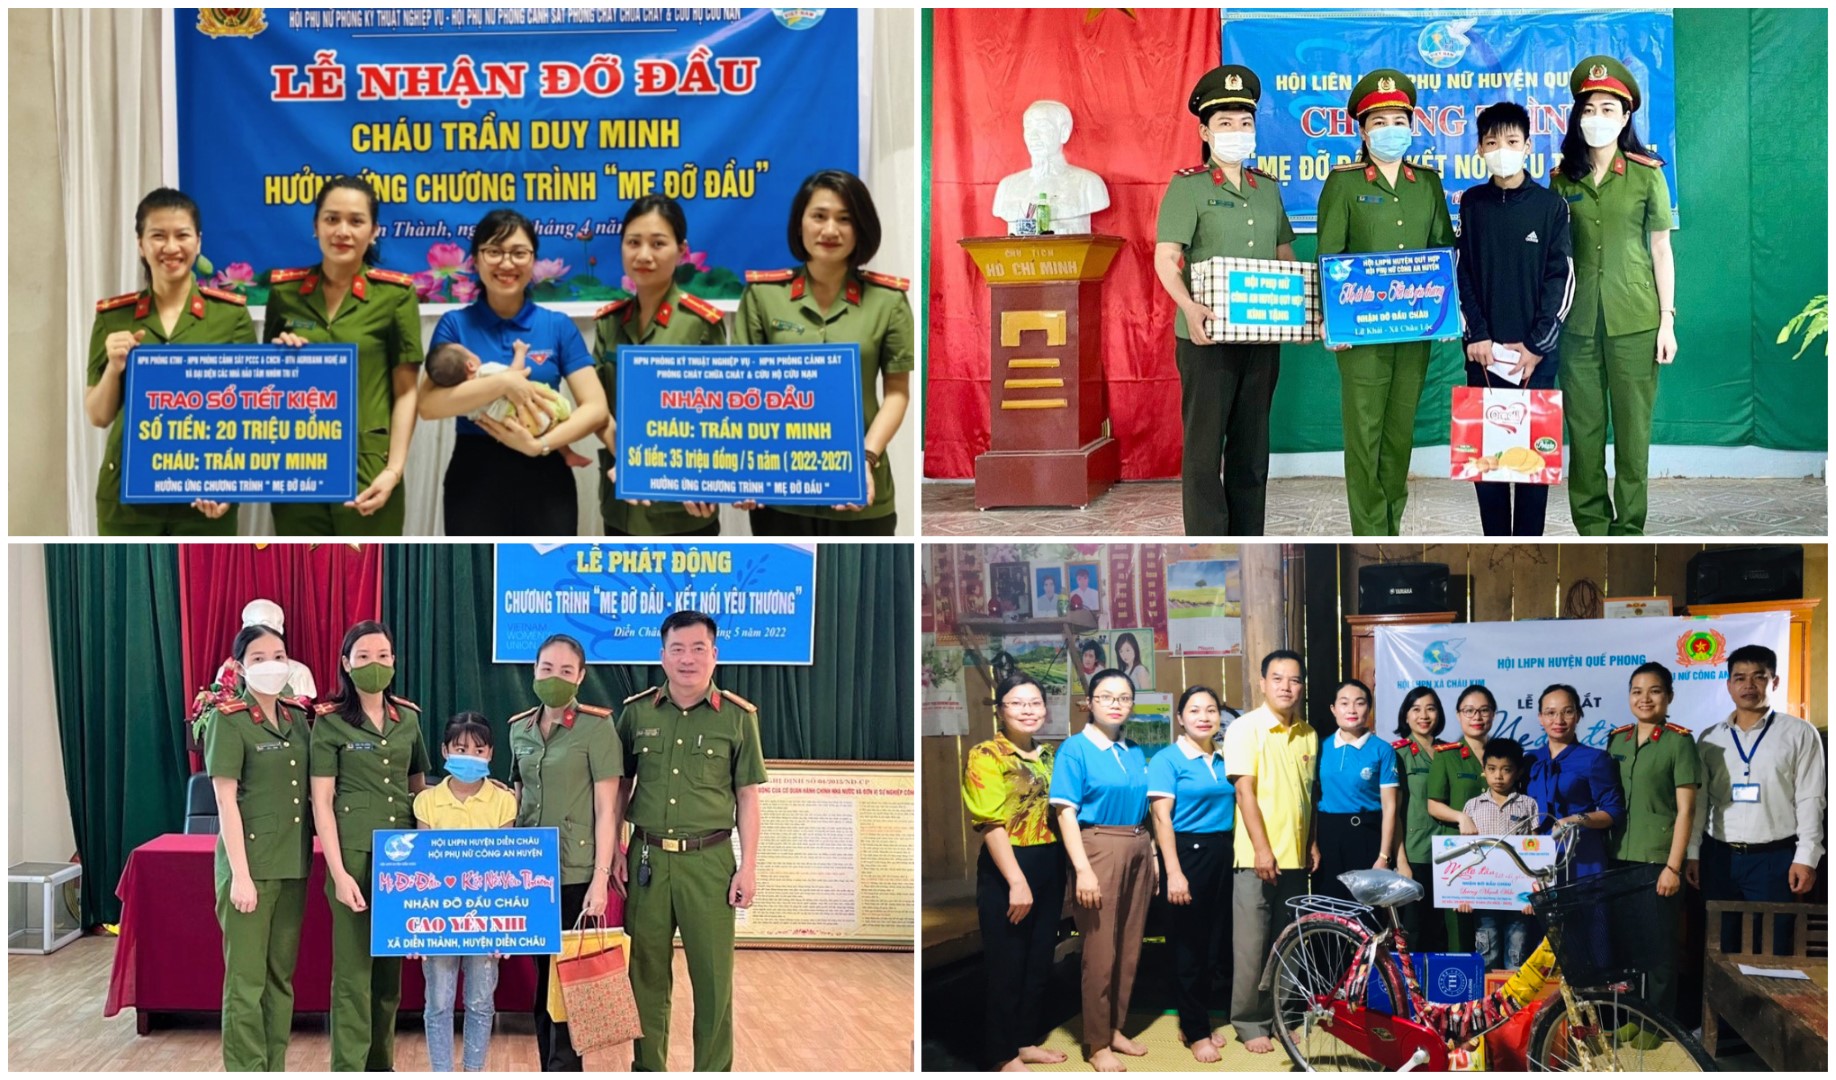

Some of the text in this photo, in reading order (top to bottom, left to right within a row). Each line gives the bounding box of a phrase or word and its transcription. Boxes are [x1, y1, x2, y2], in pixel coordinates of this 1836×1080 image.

[271, 44, 760, 109] LỄ NHẬN ĐỠ ĐẦU
[1276, 71, 1538, 94] HỘI LIÊN NỮ HUYỆN
[352, 111, 680, 152] CHÁU TRẦN DUY MINH
[1300, 152, 1330, 180] ĐỠ
[416, 171, 515, 202] CHƯƠNG
[523, 166, 596, 201] TRÌNH
[664, 164, 698, 199] ĐỠ
[580, 220, 590, 234] 4
[1040, 261, 1077, 275] MINH
[146, 390, 203, 409] TRAO
[240, 384, 283, 409] TIẾT
[287, 388, 337, 413] KIỆM
[661, 384, 814, 413] NHẬN ĐỠ ĐẦU
[138, 411, 342, 444] SỐ TIỀN: 20 TRIỆU ĐỒNG
[646, 417, 831, 439] CHÁU: TRẦN DUY MINH
[152, 447, 327, 470] CHÁU: TRẦN DUY MINH
[628, 445, 643, 466] Số
[670, 449, 683, 468] 35
[686, 448, 710, 473] triệu
[740, 450, 745, 469] /
[748, 451, 754, 470] 5
[757, 451, 780, 470] năm
[204, 479, 237, 492] CHƯƠNG
[239, 479, 263, 491] TRÌNH
[272, 480, 285, 494] MẸ
[701, 479, 736, 492] CHƯƠNG
[738, 479, 764, 493] TRÌNH
[774, 482, 787, 496] MẸ
[608, 547, 667, 573] PHÁT
[671, 550, 732, 577] ĐỘNG
[505, 590, 552, 614] CHƯƠNG
[556, 586, 590, 614] TRÌNH
[621, 587, 637, 614] ĐỠ
[640, 585, 664, 614] ĐẦU
[675, 586, 697, 614] KẾT
[700, 587, 720, 615] NỐI
[725, 588, 746, 614] YÊU
[734, 627, 740, 637] 5
[742, 626, 763, 637] năm
[765, 627, 786, 638] 2022
[1498, 652, 1646, 671] HỘI LHPN HUYỆN QUẾ PHONG
[1693, 670, 1715, 680] CÔNG
[1518, 694, 1533, 709] LỄ
[431, 837, 446, 848] HỘI
[448, 838, 468, 846] LHPN
[469, 837, 495, 847] HUYỆN
[517, 836, 539, 845] CHÂU
[428, 850, 443, 859] HỘI
[445, 851, 460, 860] PHỤ
[476, 849, 500, 858] CÔNG
[517, 848, 542, 859] HUYỆN
[404, 896, 438, 910] NHẬN
[406, 916, 446, 934] CAO
[449, 910, 488, 933] YẾN
[427, 936, 460, 948] THÀNH,
[463, 937, 490, 948] HUYỆN
[519, 935, 546, 946] CHÂU
